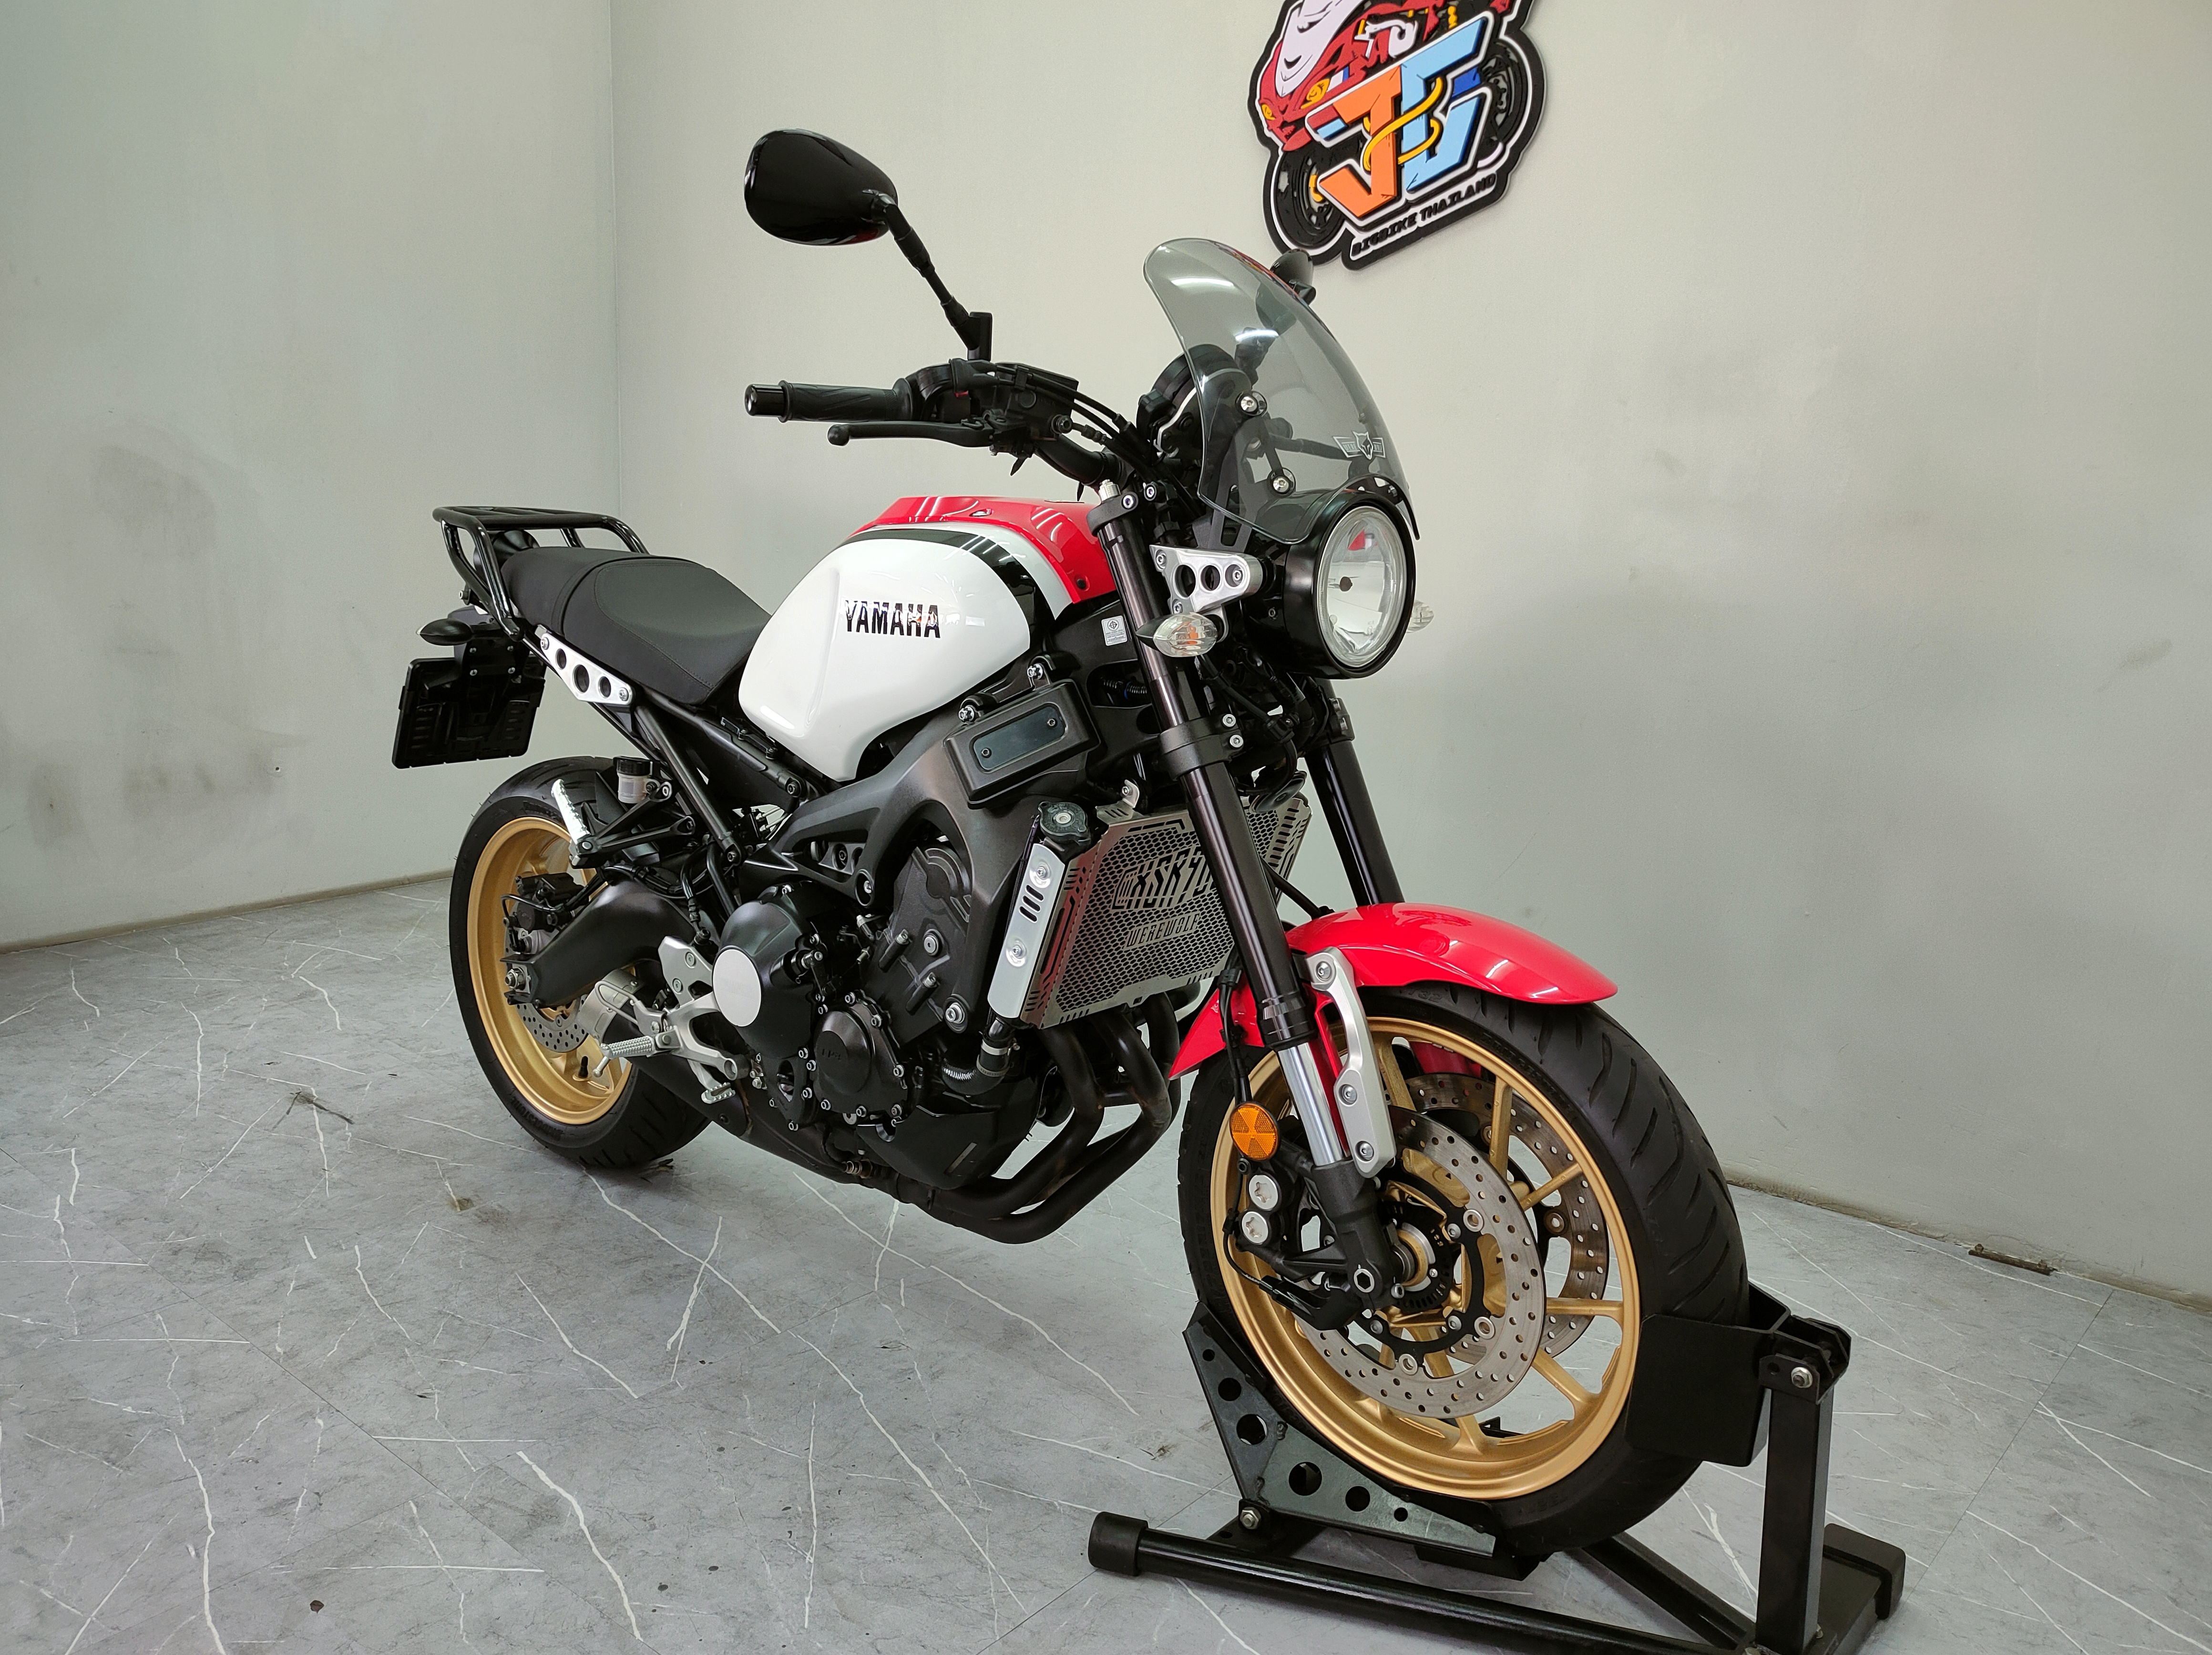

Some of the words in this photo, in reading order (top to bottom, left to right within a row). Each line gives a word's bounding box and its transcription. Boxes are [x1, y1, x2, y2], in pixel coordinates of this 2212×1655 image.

[1351, 212, 1417, 256] BIGBIKE
[1419, 173, 1496, 221] THAILAND
[845, 600, 941, 638] YAMAHA
[1126, 913, 1200, 948] WEREWOLF
